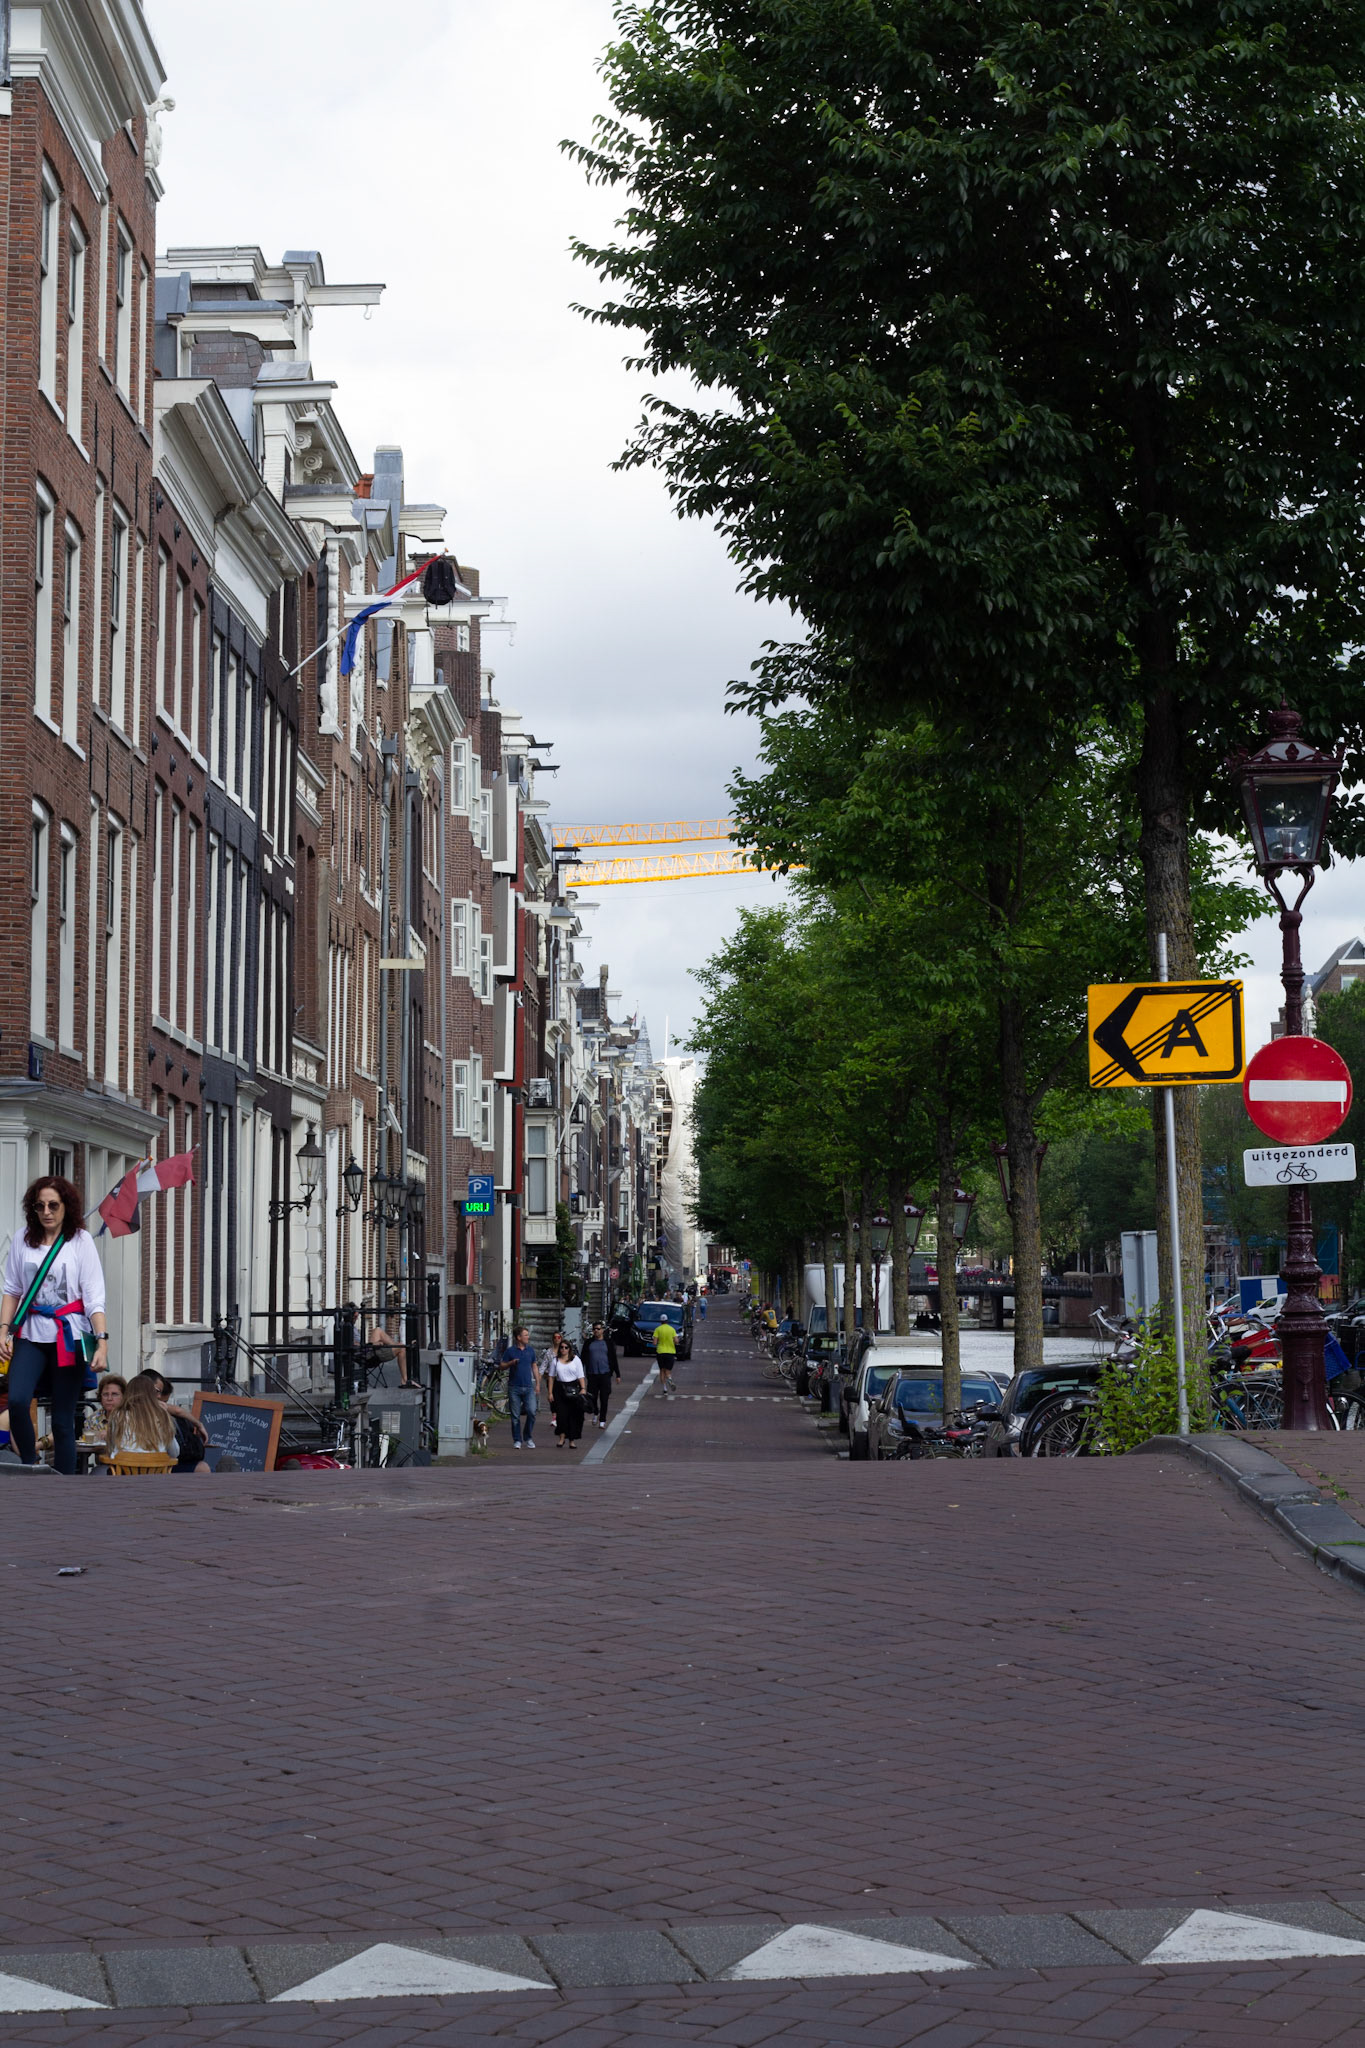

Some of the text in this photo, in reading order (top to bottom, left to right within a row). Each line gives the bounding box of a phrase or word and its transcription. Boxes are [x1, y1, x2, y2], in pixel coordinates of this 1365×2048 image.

[1160, 1009, 1209, 1058] A
[1251, 1146, 1349, 1163] uitgezonderd
[473, 1182, 482, 1193] P
[465, 1202, 490, 1212] VRIJ
[239, 1412, 269, 1429] AVOCADO
